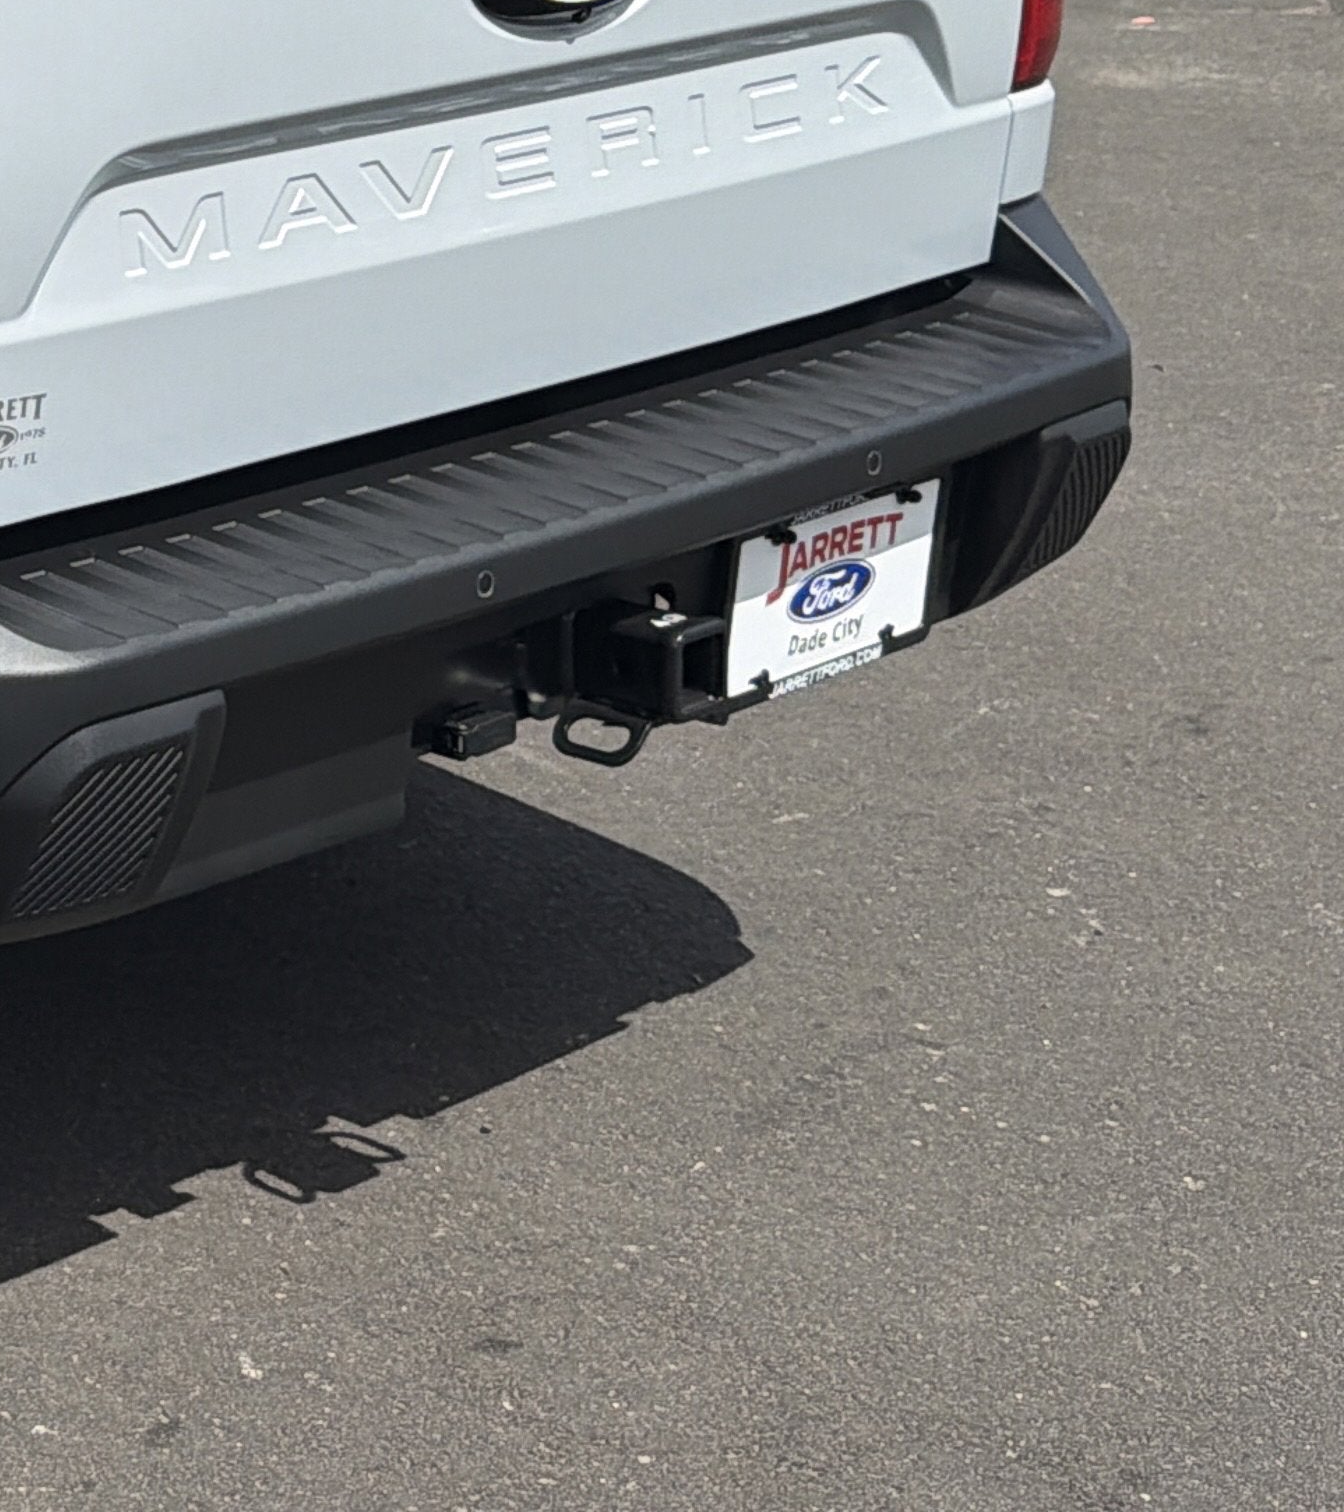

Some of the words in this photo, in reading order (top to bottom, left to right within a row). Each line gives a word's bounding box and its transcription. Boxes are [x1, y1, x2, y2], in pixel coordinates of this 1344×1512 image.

[118, 54, 889, 278] MAVERICK
[23, 452, 38, 466] FL
[765, 512, 904, 607] JARRETT
[802, 569, 859, 616] Ford
[787, 628, 828, 656] Dade
[832, 614, 865, 642] City
